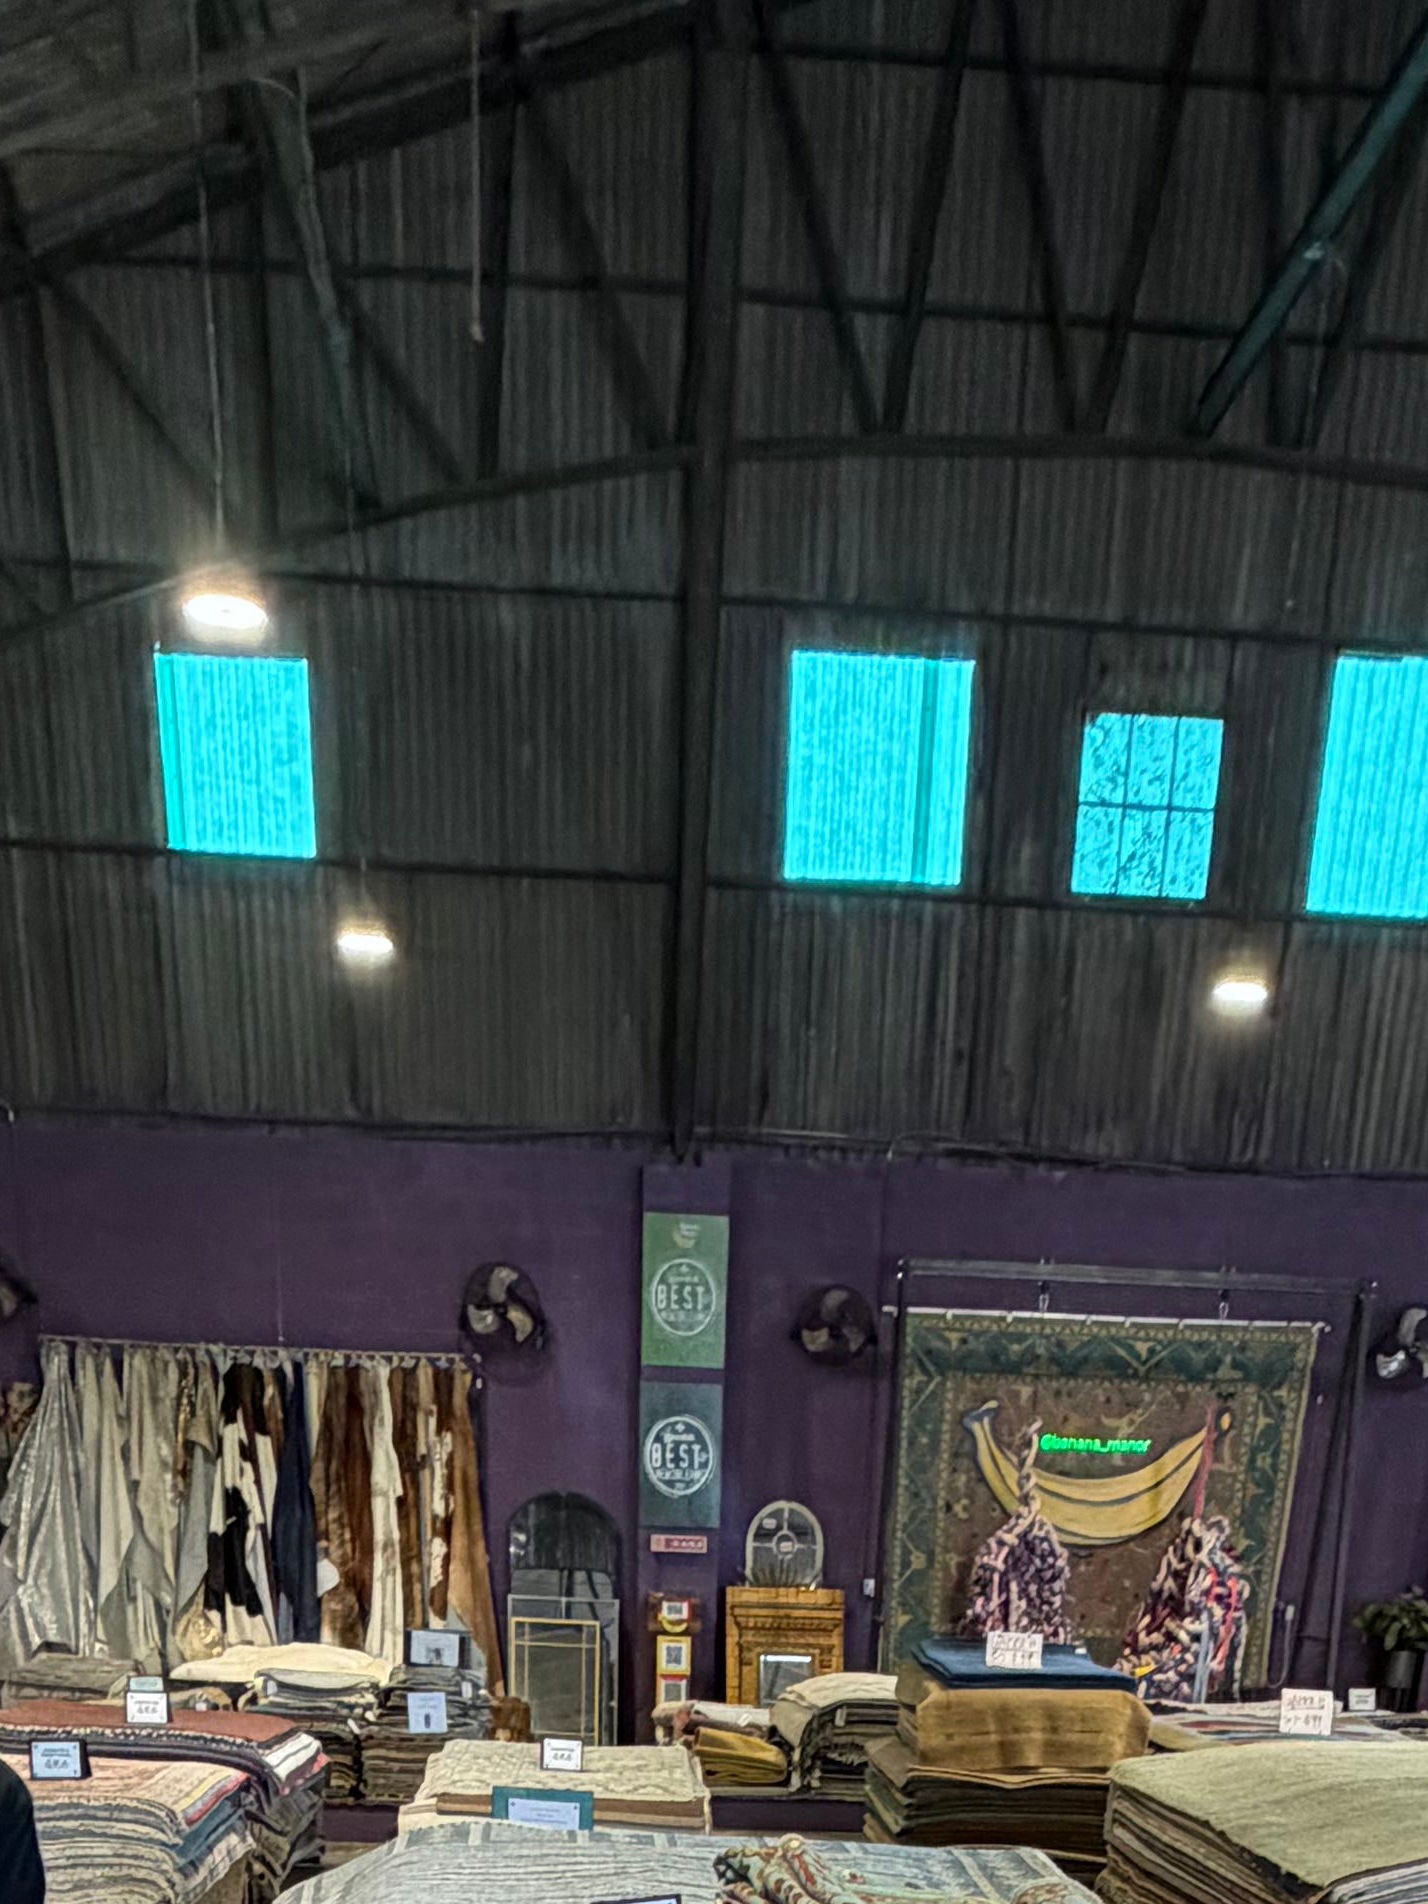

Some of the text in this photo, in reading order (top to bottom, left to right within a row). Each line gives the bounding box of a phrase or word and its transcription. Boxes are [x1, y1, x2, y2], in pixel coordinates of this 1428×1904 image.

[656, 1284, 704, 1310] BEST
[651, 1442, 703, 1469] BEST
[1040, 1433, 1151, 1453] @banana_manor
